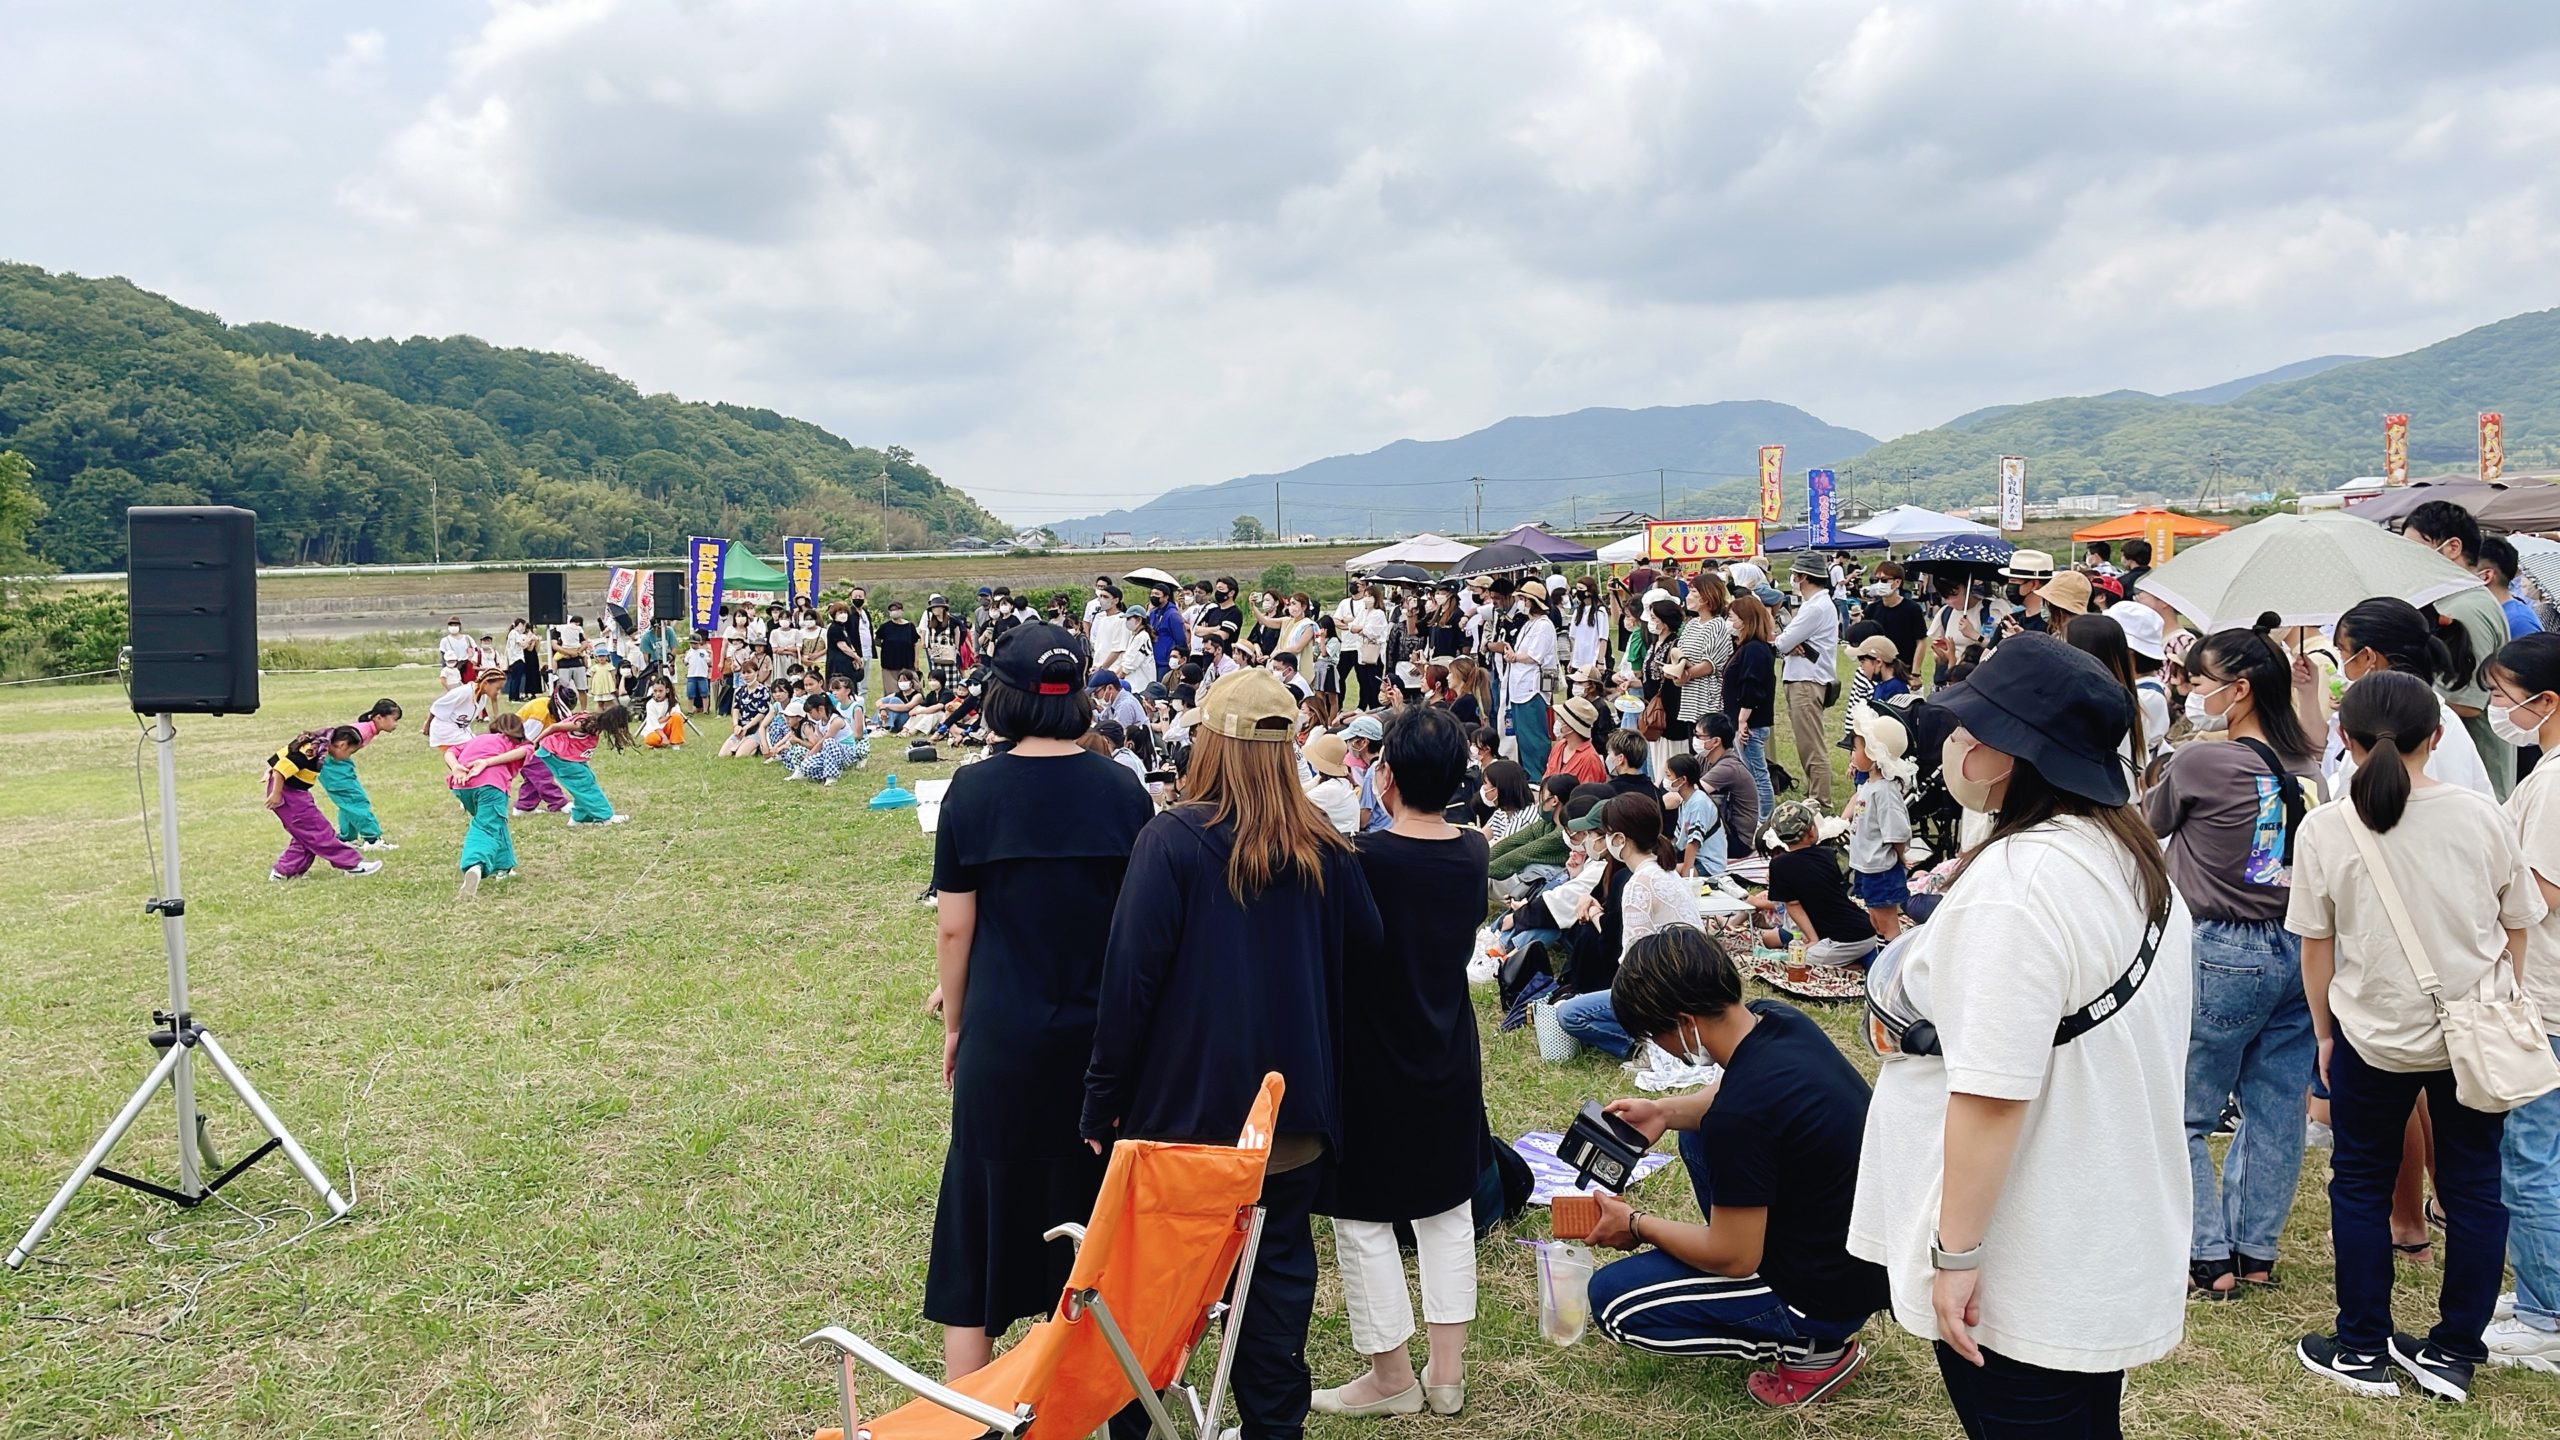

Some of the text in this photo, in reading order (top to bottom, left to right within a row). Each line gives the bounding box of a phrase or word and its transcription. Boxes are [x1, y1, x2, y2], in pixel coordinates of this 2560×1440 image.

[1661, 533, 1745, 555] くじびき
[2127, 956, 2146, 987] UGG
[2087, 992, 2118, 1021] UGG
